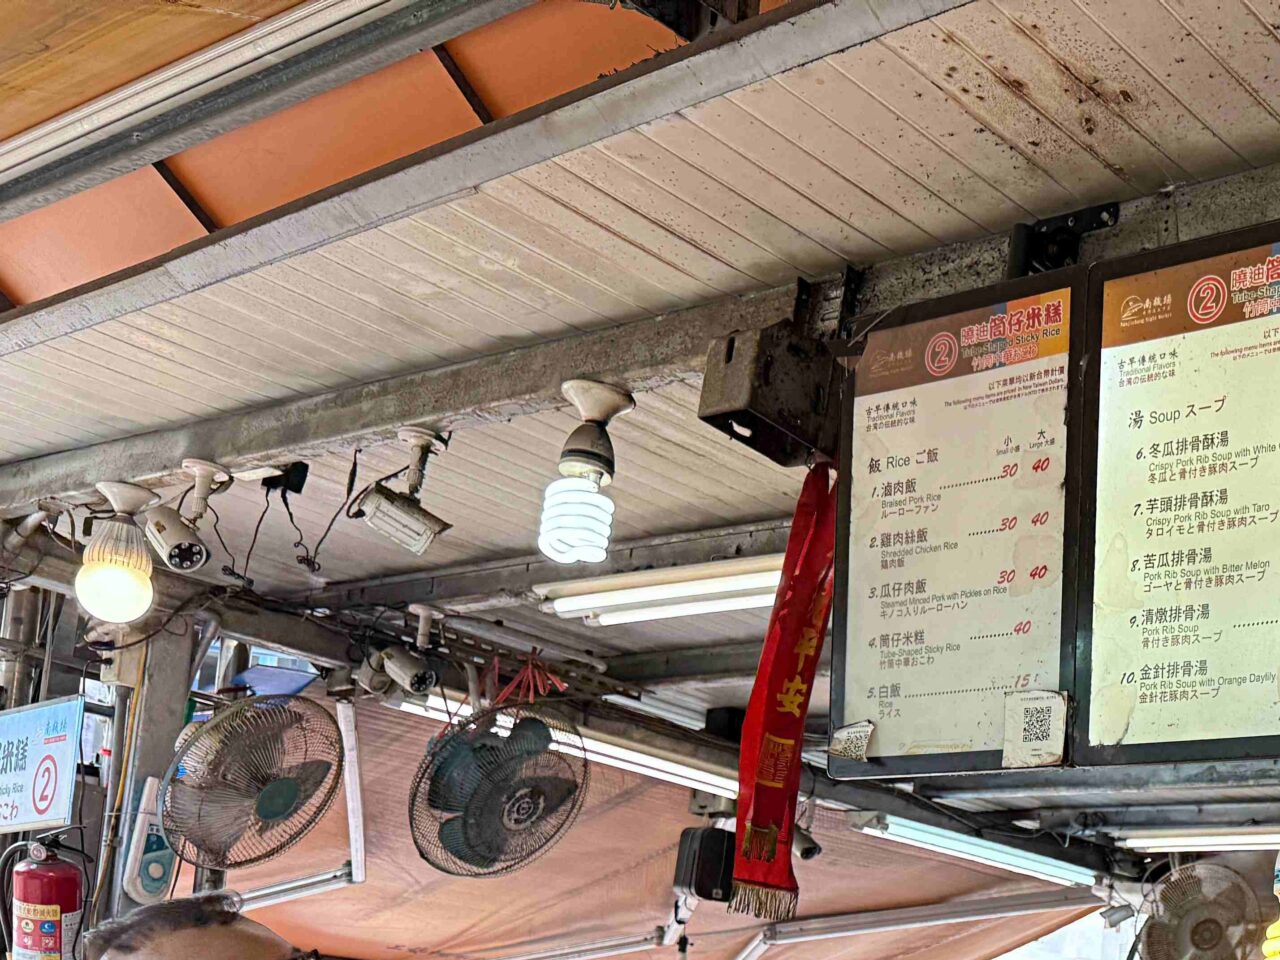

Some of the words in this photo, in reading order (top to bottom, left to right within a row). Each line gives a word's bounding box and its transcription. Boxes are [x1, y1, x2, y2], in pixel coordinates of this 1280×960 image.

[1148, 408, 1181, 425] Soup
[1184, 394, 1227, 418] スープ
[1003, 434, 1012, 447] 小
[1036, 429, 1046, 441] 大
[885, 454, 910, 470] Rice
[1031, 456, 1050, 473] 40
[1148, 460, 1173, 472] Crispy
[1175, 455, 1193, 469] Pork
[1195, 453, 1209, 466] Rib
[1210, 450, 1232, 464] Soup
[1234, 445, 1250, 458] with
[1252, 442, 1276, 457] White
[999, 461, 1018, 479] 30
[880, 496, 907, 509] Braised
[908, 494, 924, 505] Pork
[925, 492, 941, 502] Rice
[998, 515, 1017, 532] 30
[1030, 510, 1049, 527] 40
[996, 568, 1016, 584] 30
[1029, 563, 1048, 580] 40
[1013, 619, 1031, 635] 40
